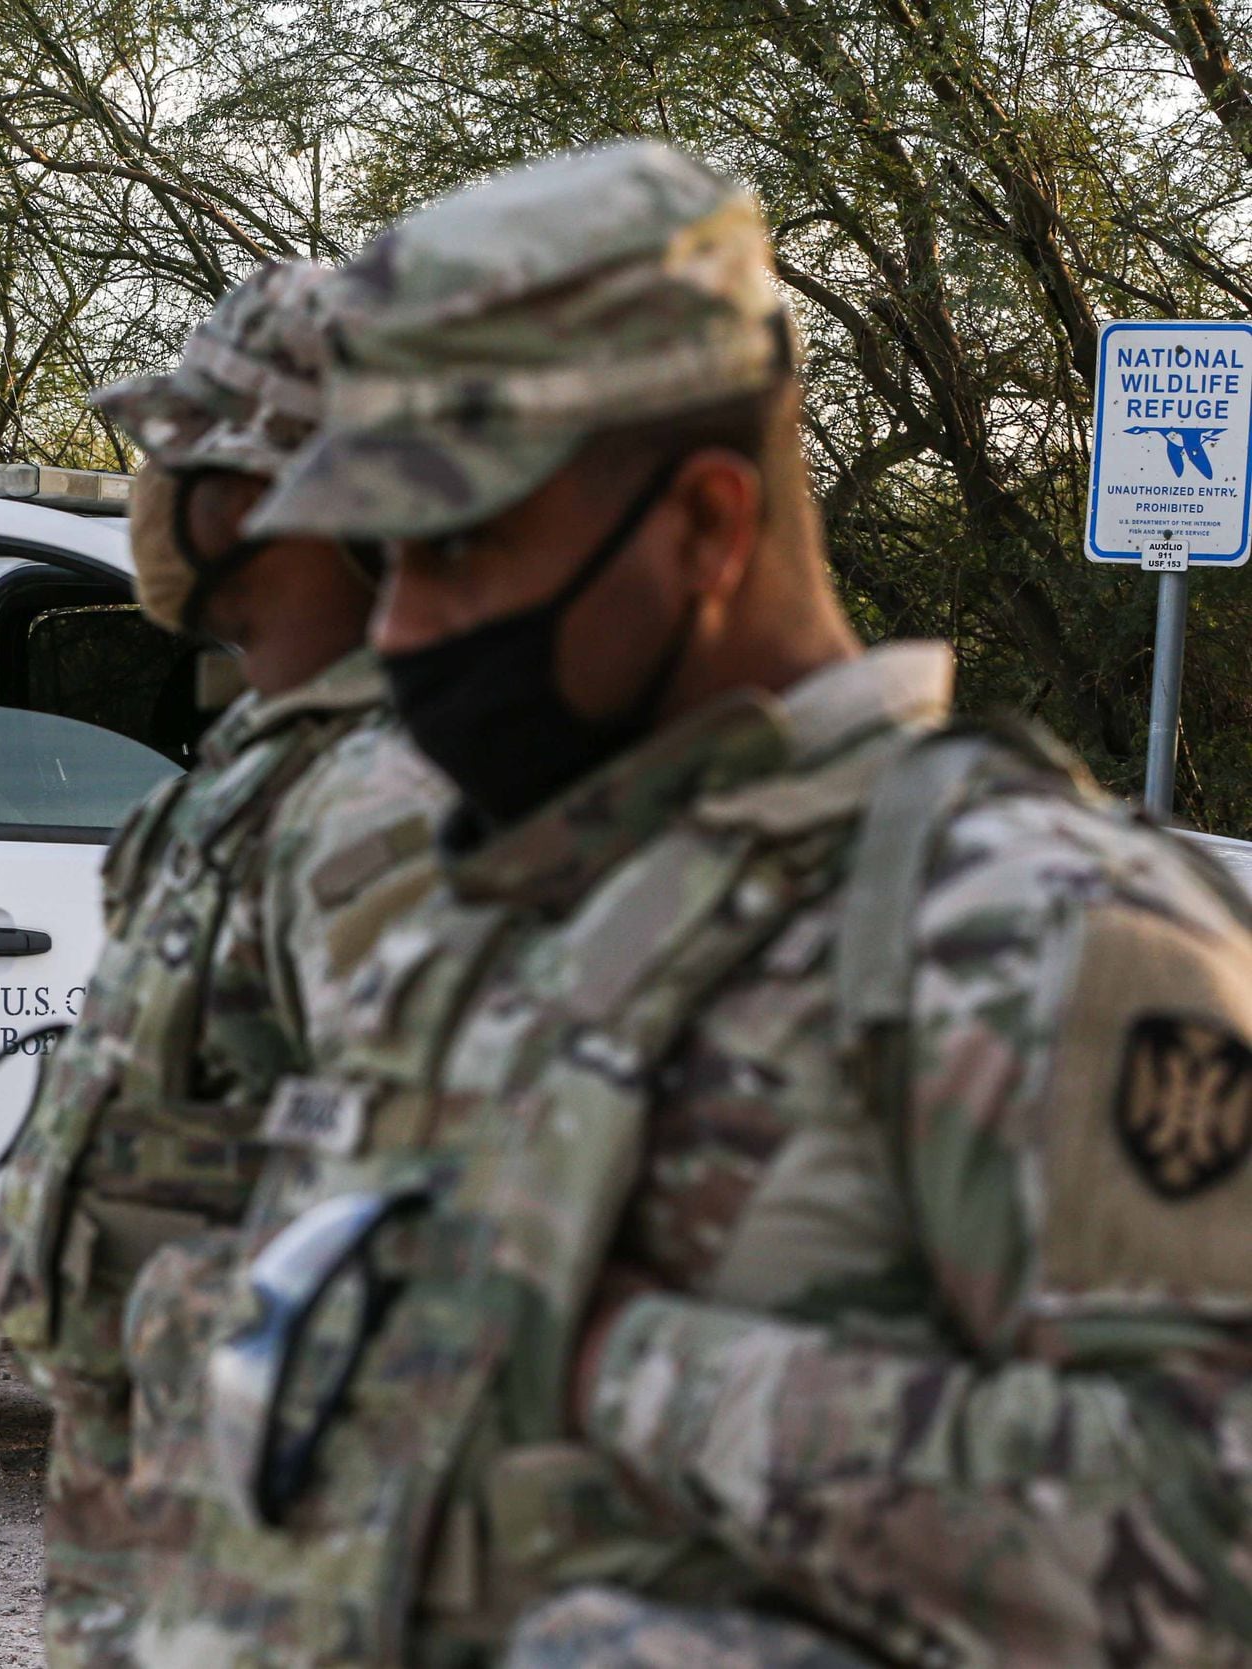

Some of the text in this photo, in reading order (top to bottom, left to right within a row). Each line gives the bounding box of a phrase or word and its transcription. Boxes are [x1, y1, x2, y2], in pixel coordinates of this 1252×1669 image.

[1117, 348, 1244, 368] NATIONAL
[1121, 373, 1239, 394] WILDLIFE
[1127, 399, 1229, 419] REFUGE
[1107, 485, 1235, 497] UNAUTHORIZED ENTRY
[1136, 503, 1204, 513] PROHIBITED
[1166, 560, 1181, 568] 153
[0, 986, 57, 1016] U.S.
[0, 1027, 56, 1056] Bor
